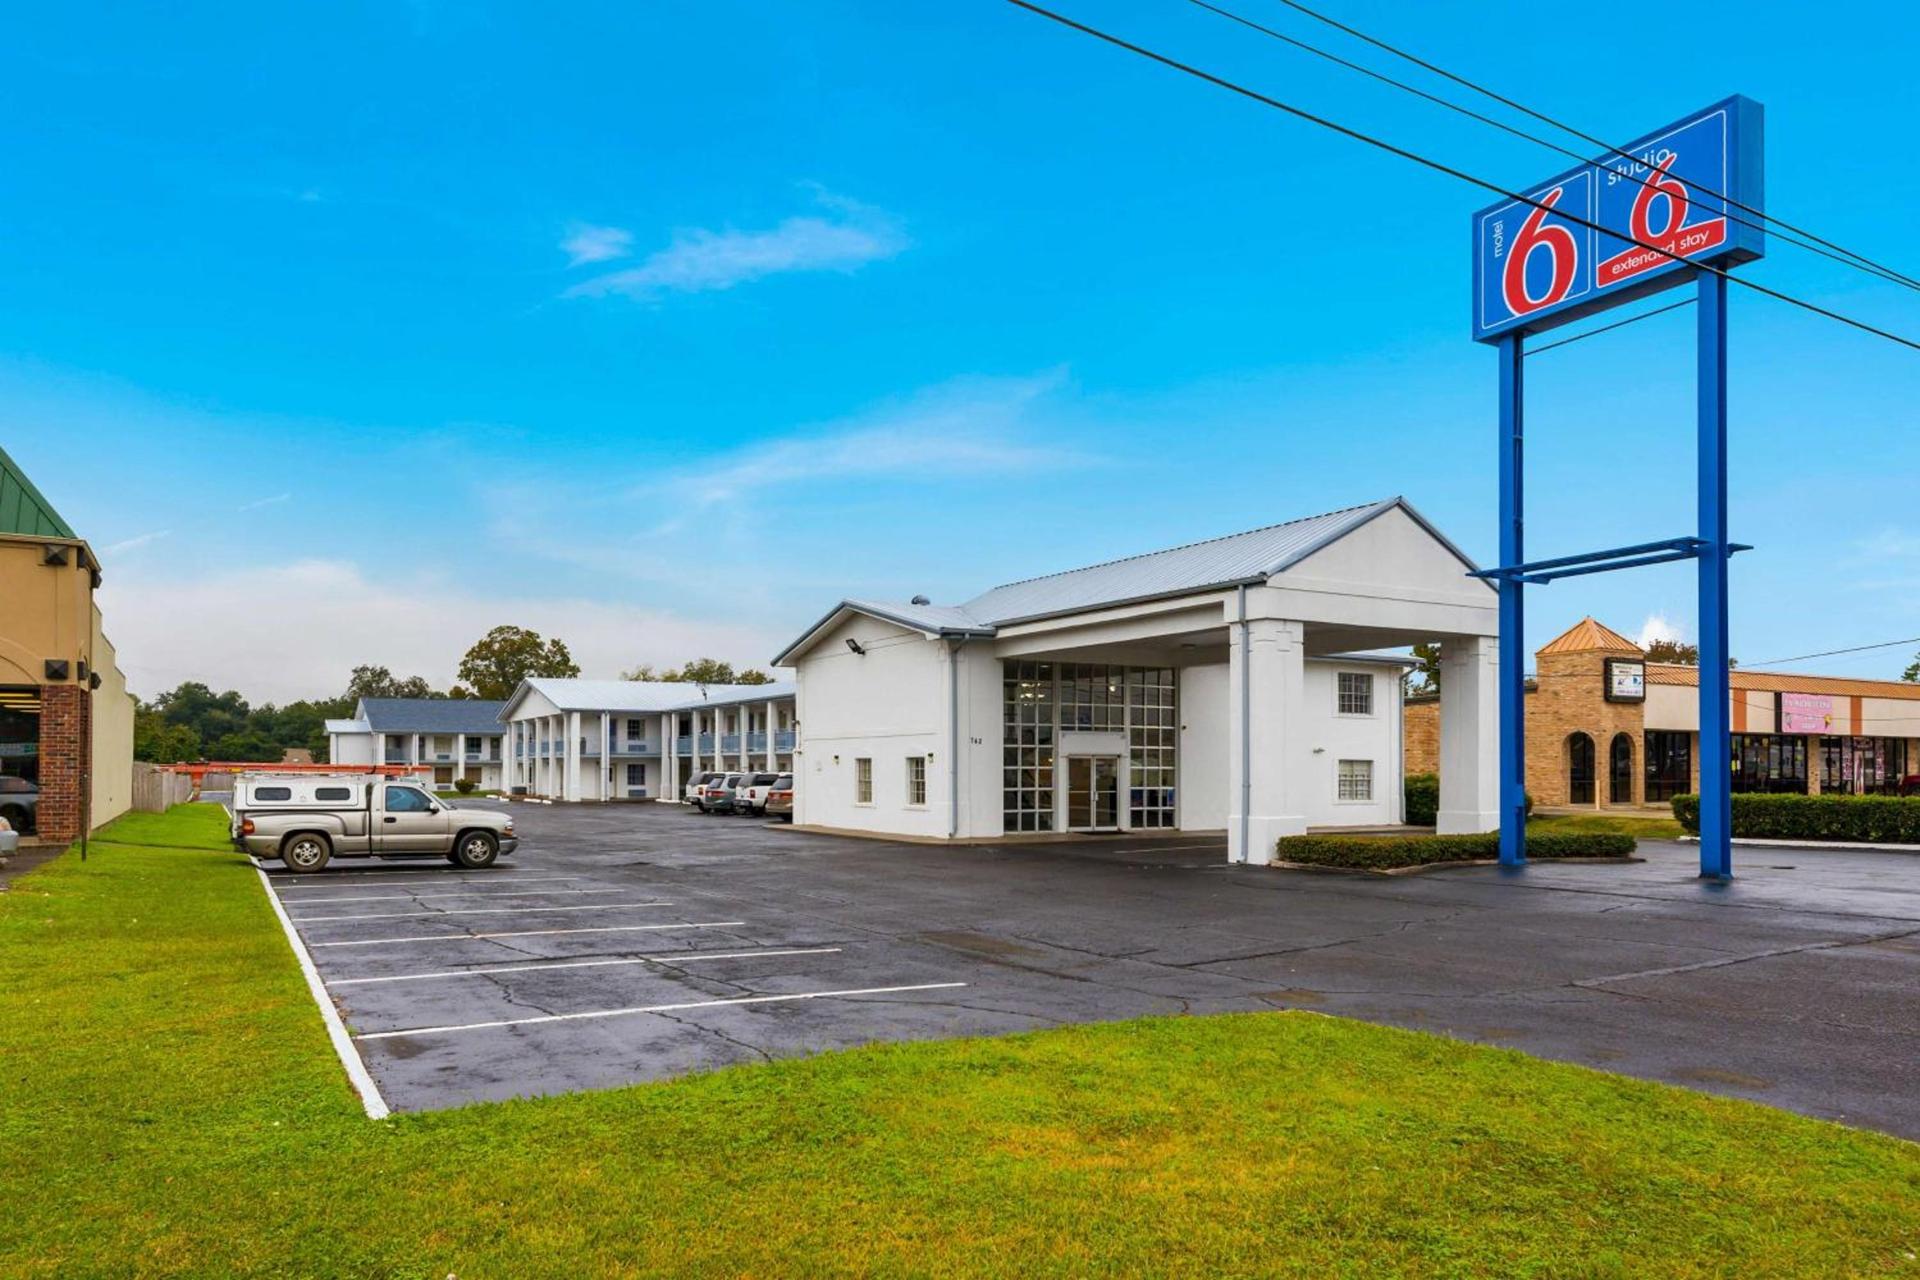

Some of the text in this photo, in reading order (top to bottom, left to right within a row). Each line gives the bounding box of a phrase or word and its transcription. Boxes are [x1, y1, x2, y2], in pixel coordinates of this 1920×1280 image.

[1608, 149, 1670, 185] studio
[1630, 152, 1690, 248] 6
[1493, 187, 1578, 317] motel 6
[1680, 230, 1709, 250] stay
